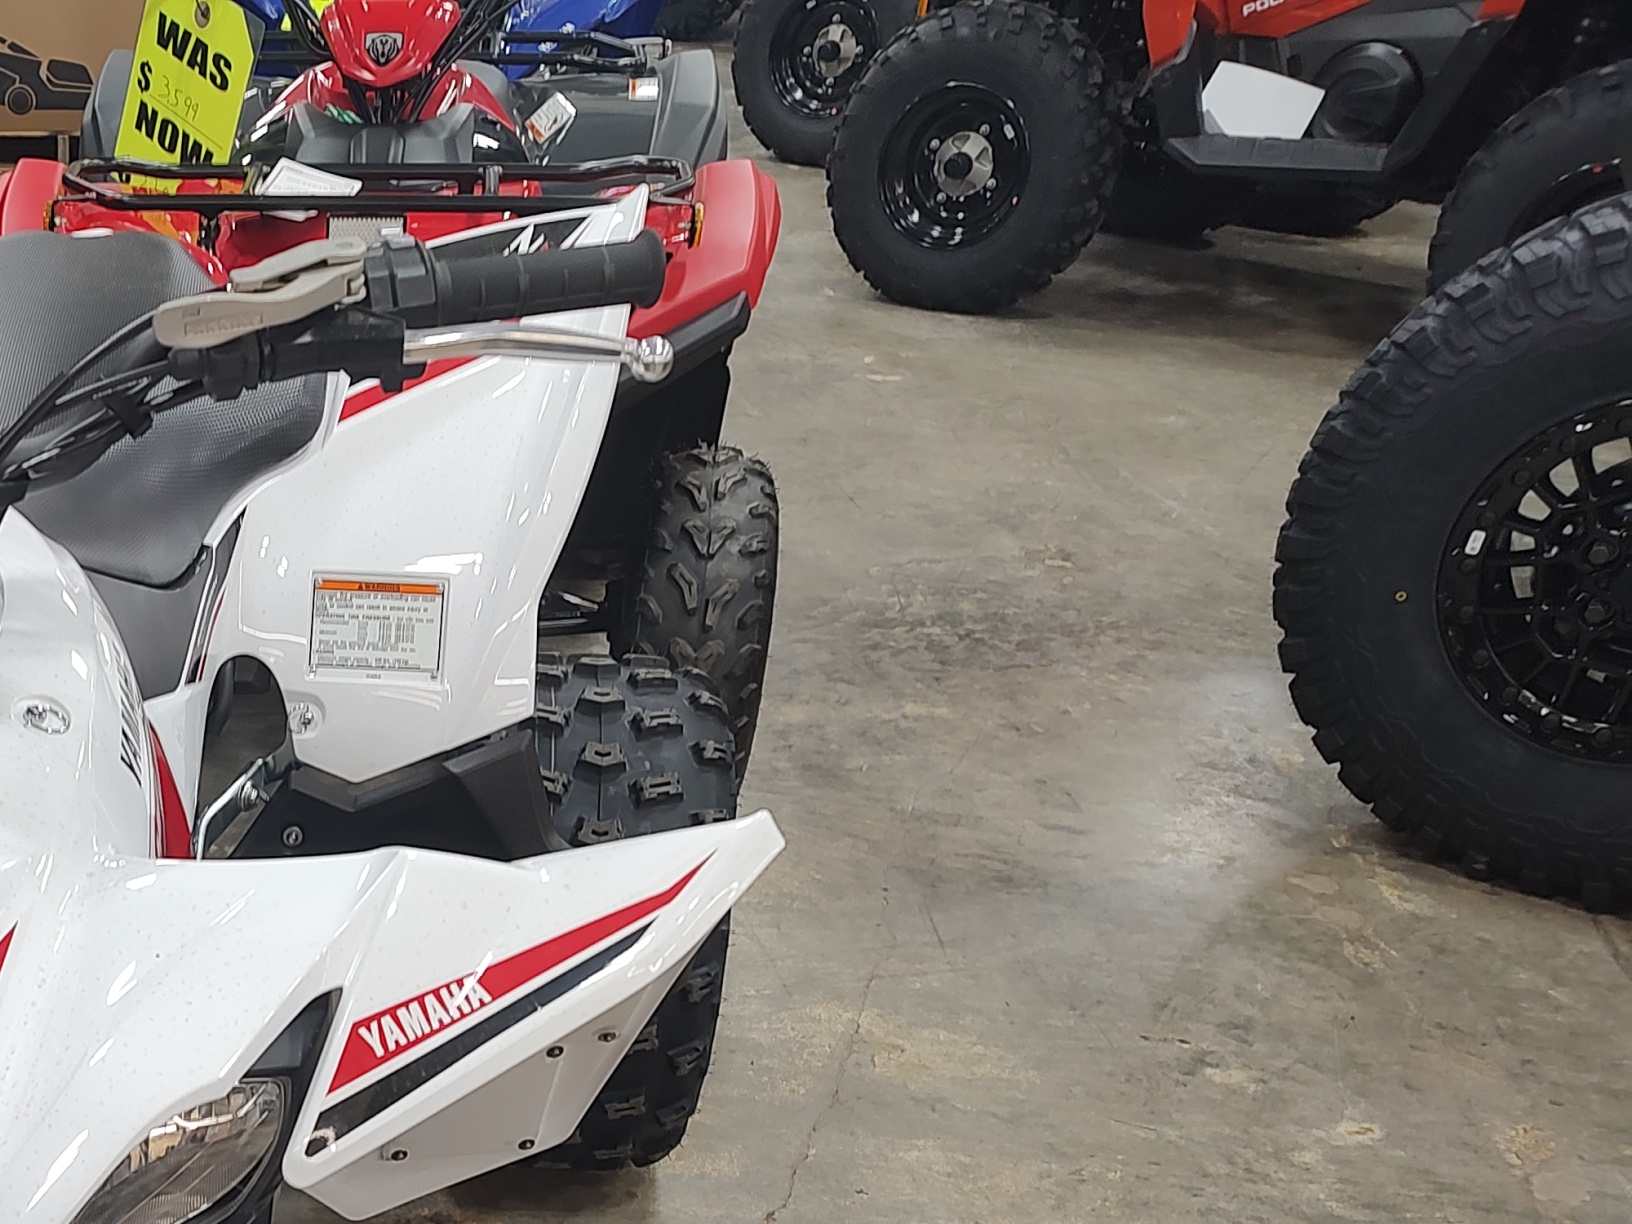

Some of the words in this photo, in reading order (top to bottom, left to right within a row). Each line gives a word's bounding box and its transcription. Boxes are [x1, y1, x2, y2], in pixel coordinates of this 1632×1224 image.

[137, 60, 153, 93] $
[156, 10, 232, 91] WAS
[135, 98, 214, 165] NOW
[357, 975, 493, 1058] YAMAHA
